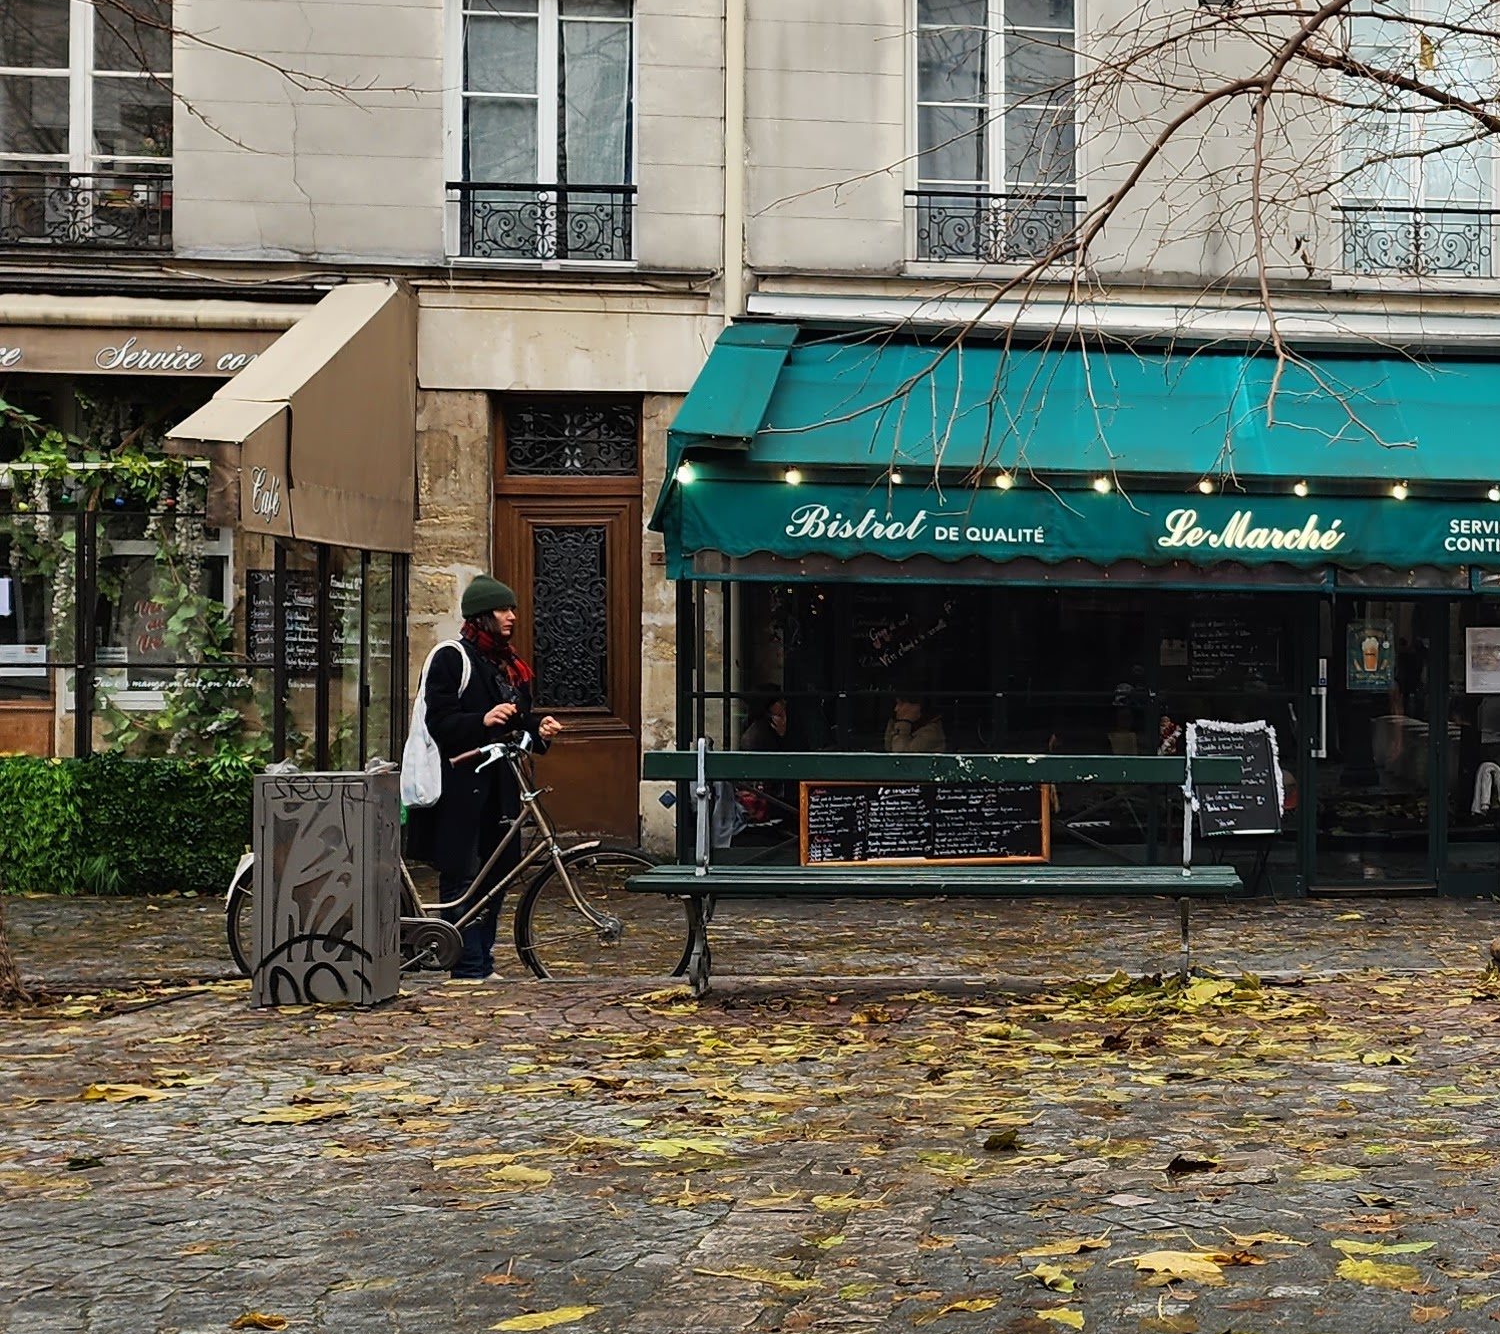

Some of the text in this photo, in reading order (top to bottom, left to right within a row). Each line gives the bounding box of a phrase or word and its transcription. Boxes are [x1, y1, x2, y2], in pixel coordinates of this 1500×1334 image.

[95, 336, 204, 370] Service
[251, 466, 281, 523] Café
[785, 504, 1045, 543] Bistrot DE QUALITÉ
[1158, 509, 1346, 550] Le Marché
